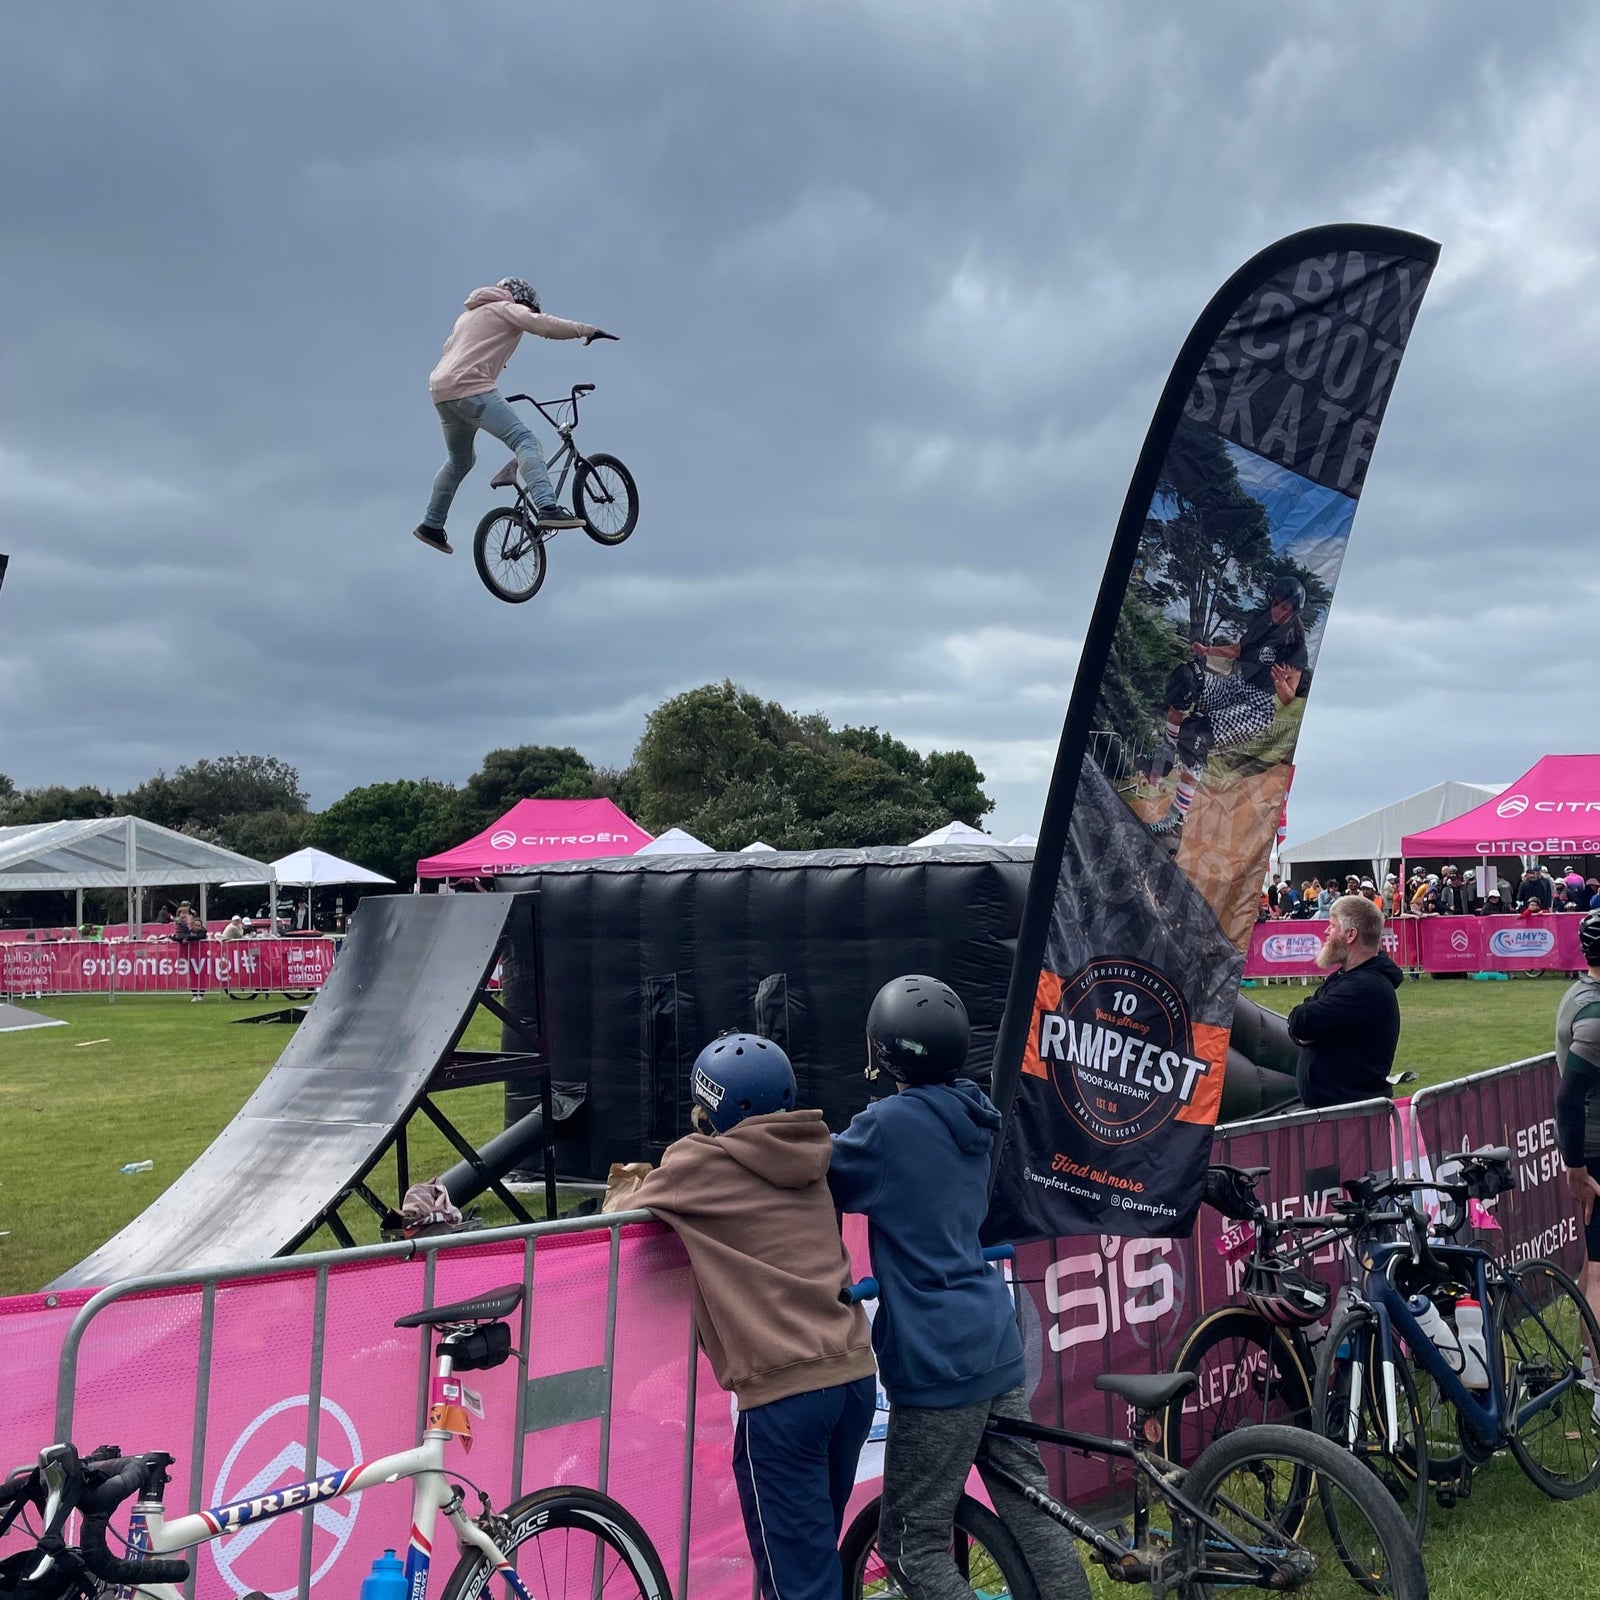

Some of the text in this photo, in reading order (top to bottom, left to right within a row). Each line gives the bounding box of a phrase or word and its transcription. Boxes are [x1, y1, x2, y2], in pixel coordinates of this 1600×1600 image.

[1293, 251, 1429, 336] BMX
[1080, 967, 1180, 1020] CELEBRATING TEN YEARS
[1112, 990, 1138, 1016] 10
[1040, 1013, 1206, 1101] RAMPFEST
[1077, 1068, 1151, 1101] INDOOR SKATEPARK
[1030, 1171, 1101, 1201] rampfest.com.au
[1051, 1152, 1145, 1194] Find out more
[1121, 1197, 1178, 1217] @rampfest
[1220, 1226, 1246, 1250] 337
[218, 1476, 336, 1524] TREK
